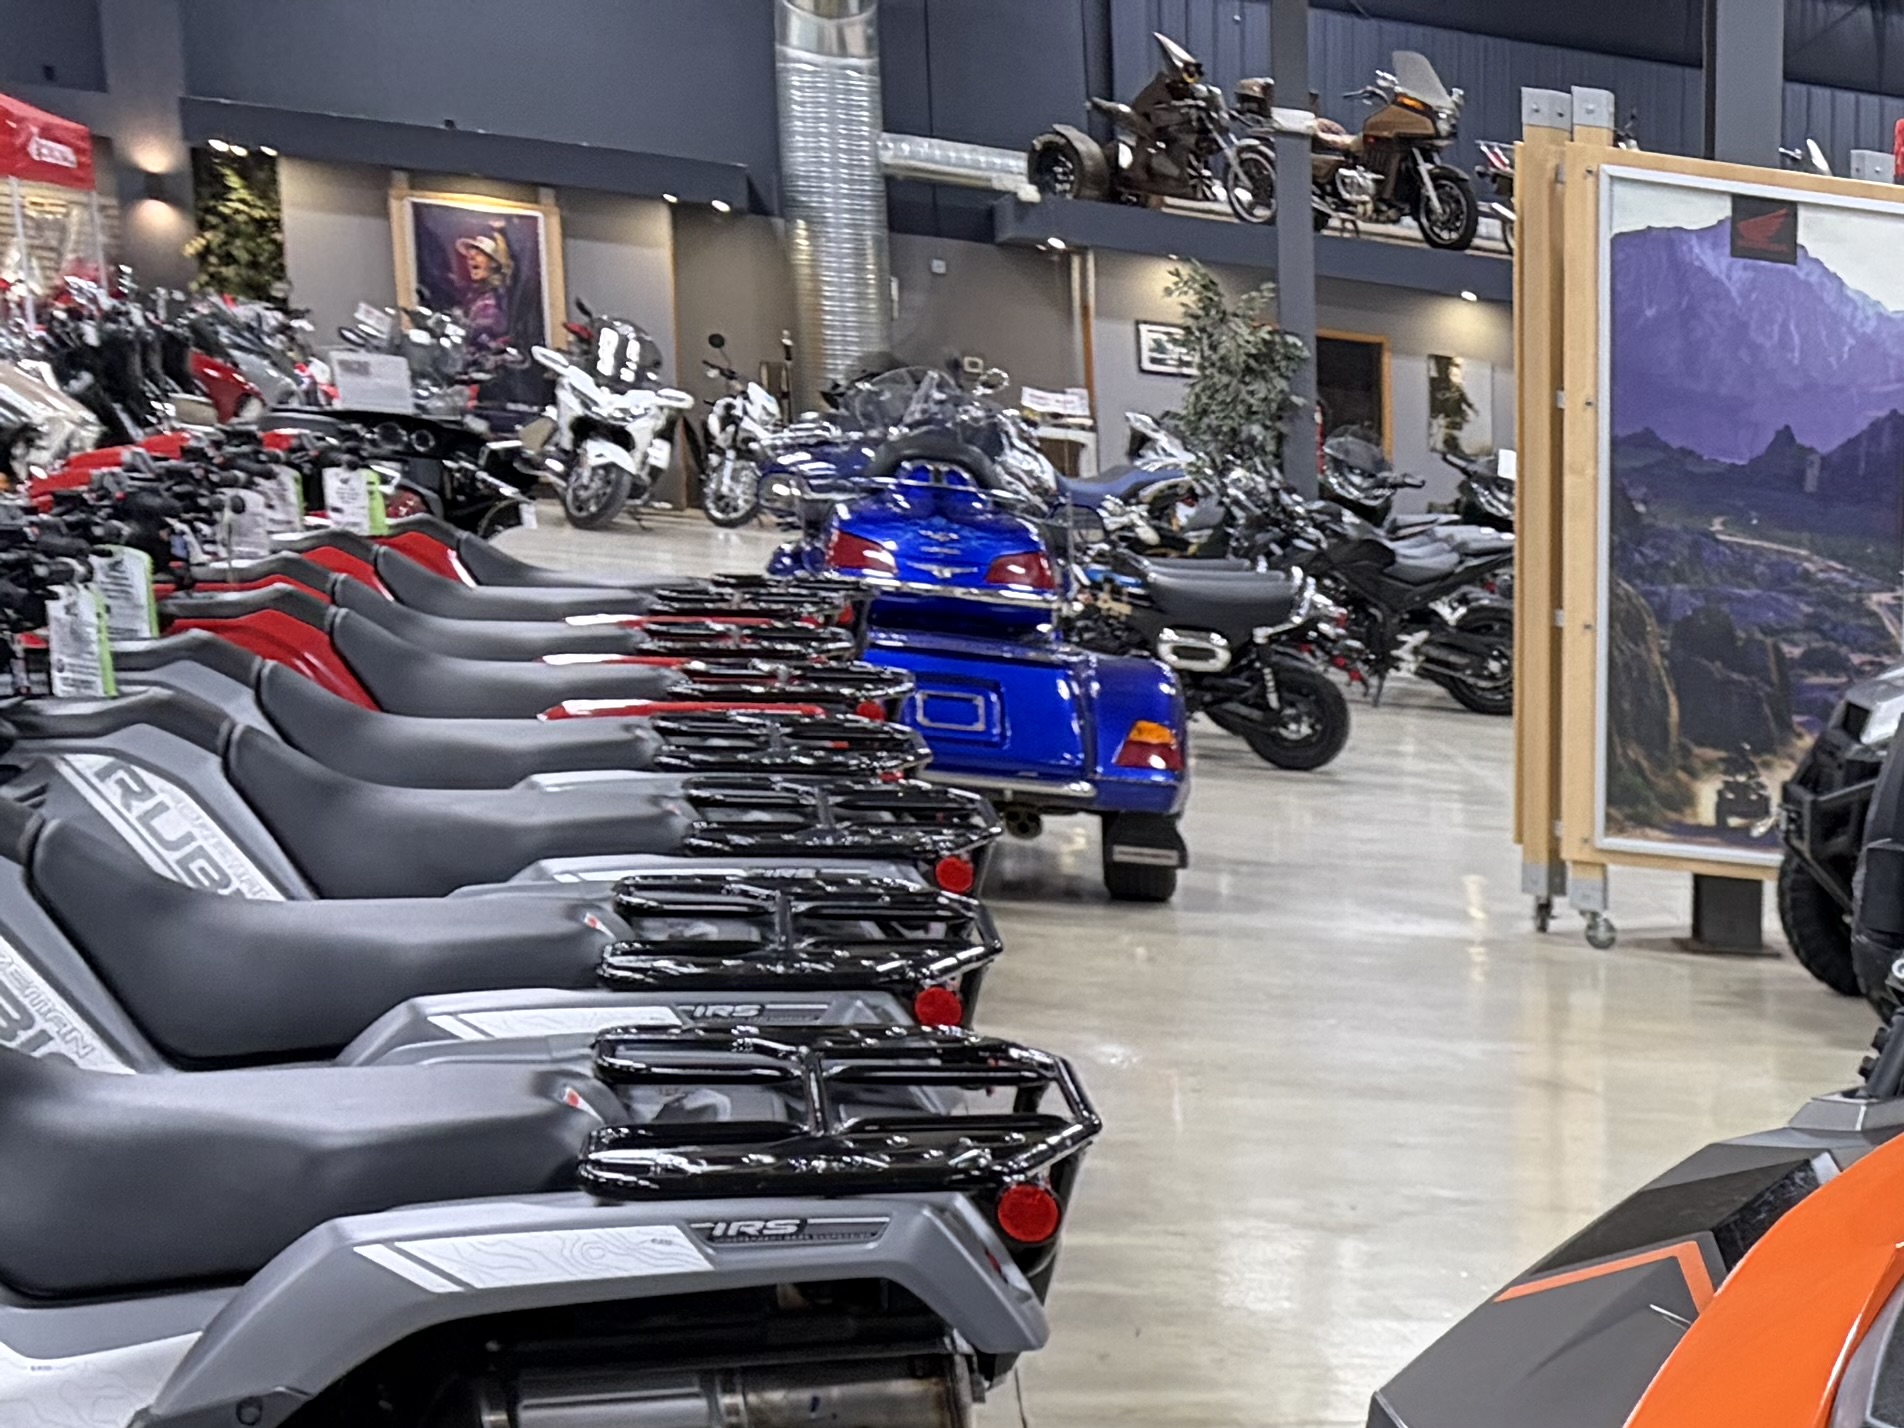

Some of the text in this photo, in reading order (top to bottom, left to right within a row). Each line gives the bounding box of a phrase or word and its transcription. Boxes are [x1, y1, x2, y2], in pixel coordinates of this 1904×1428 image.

[93, 760, 247, 898] RUB
[693, 1003, 764, 1018] IRS
[711, 1218, 801, 1237] IRS
